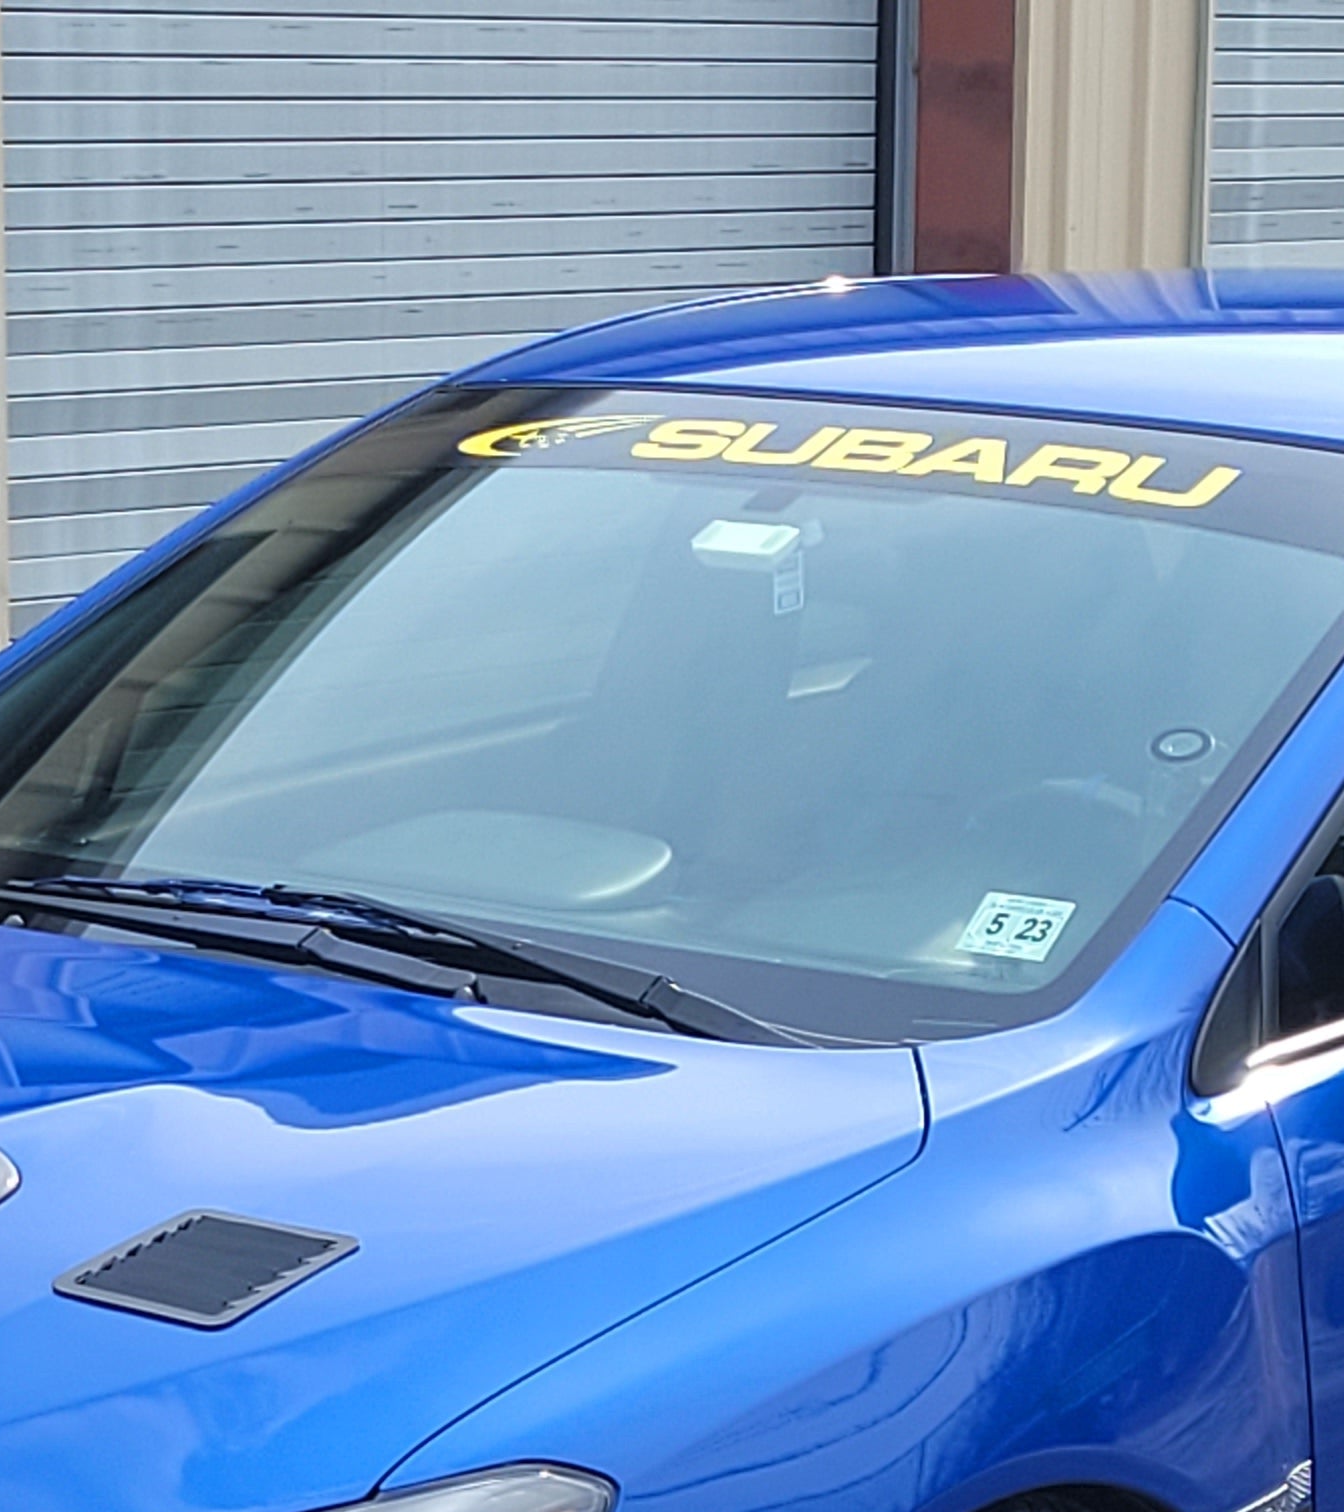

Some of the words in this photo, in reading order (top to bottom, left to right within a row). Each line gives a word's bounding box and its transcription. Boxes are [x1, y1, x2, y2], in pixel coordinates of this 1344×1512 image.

[630, 417, 1242, 508] SUBARU
[985, 912, 1011, 936] 5
[1013, 917, 1053, 943] 23
